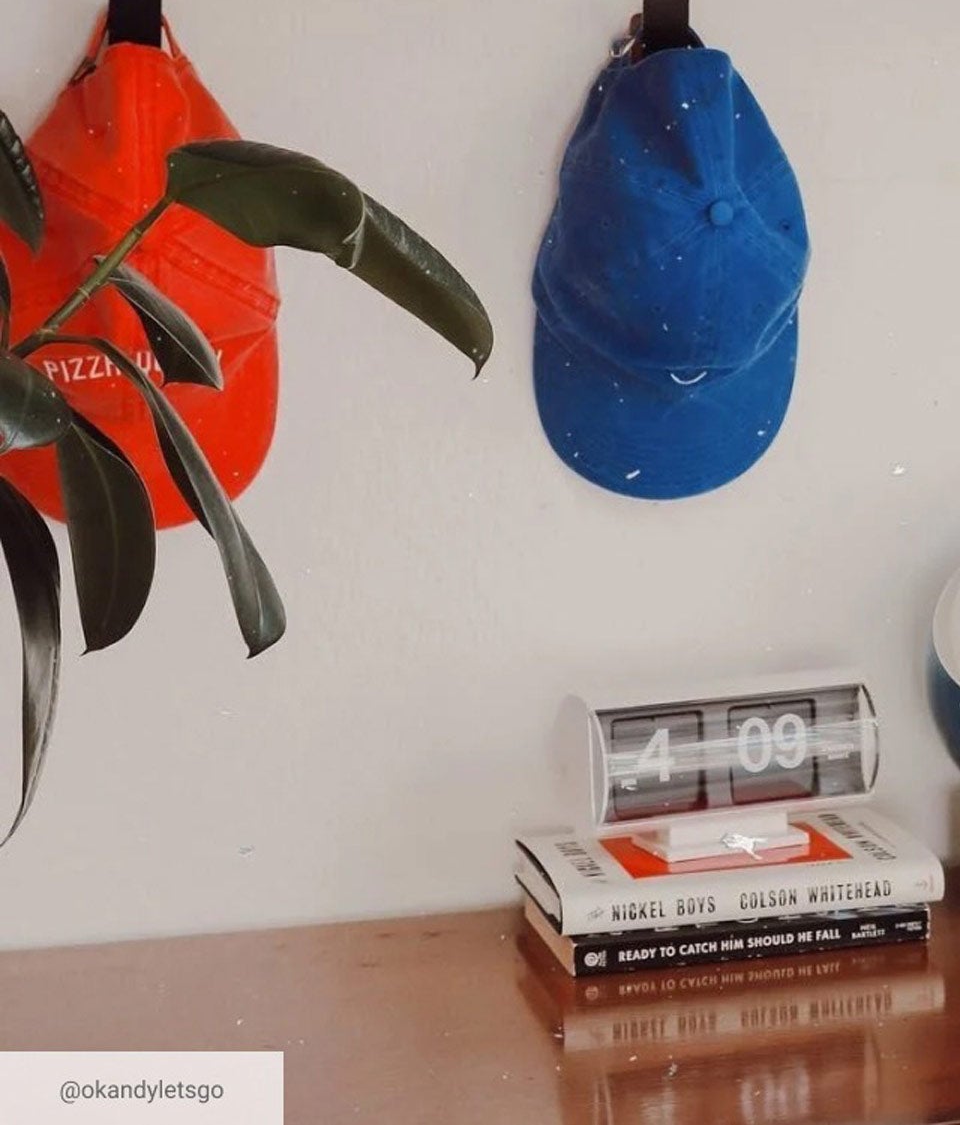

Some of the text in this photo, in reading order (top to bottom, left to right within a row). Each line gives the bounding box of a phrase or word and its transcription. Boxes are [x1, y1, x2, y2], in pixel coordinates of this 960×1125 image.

[638, 713, 807, 782] 4 09
[611, 900, 666, 922] NICKEL
[677, 896, 716, 917] BOYS
[739, 888, 798, 910] COLSON
[807, 879, 892, 903] WHITEHEAD
[618, 946, 658, 963] READY
[660, 945, 677, 958] TO
[679, 941, 718, 956] CATCH
[720, 938, 744, 952] HIM
[747, 933, 794, 949] SHOULD
[797, 931, 812, 943] HE
[815, 928, 841, 941] FALL
